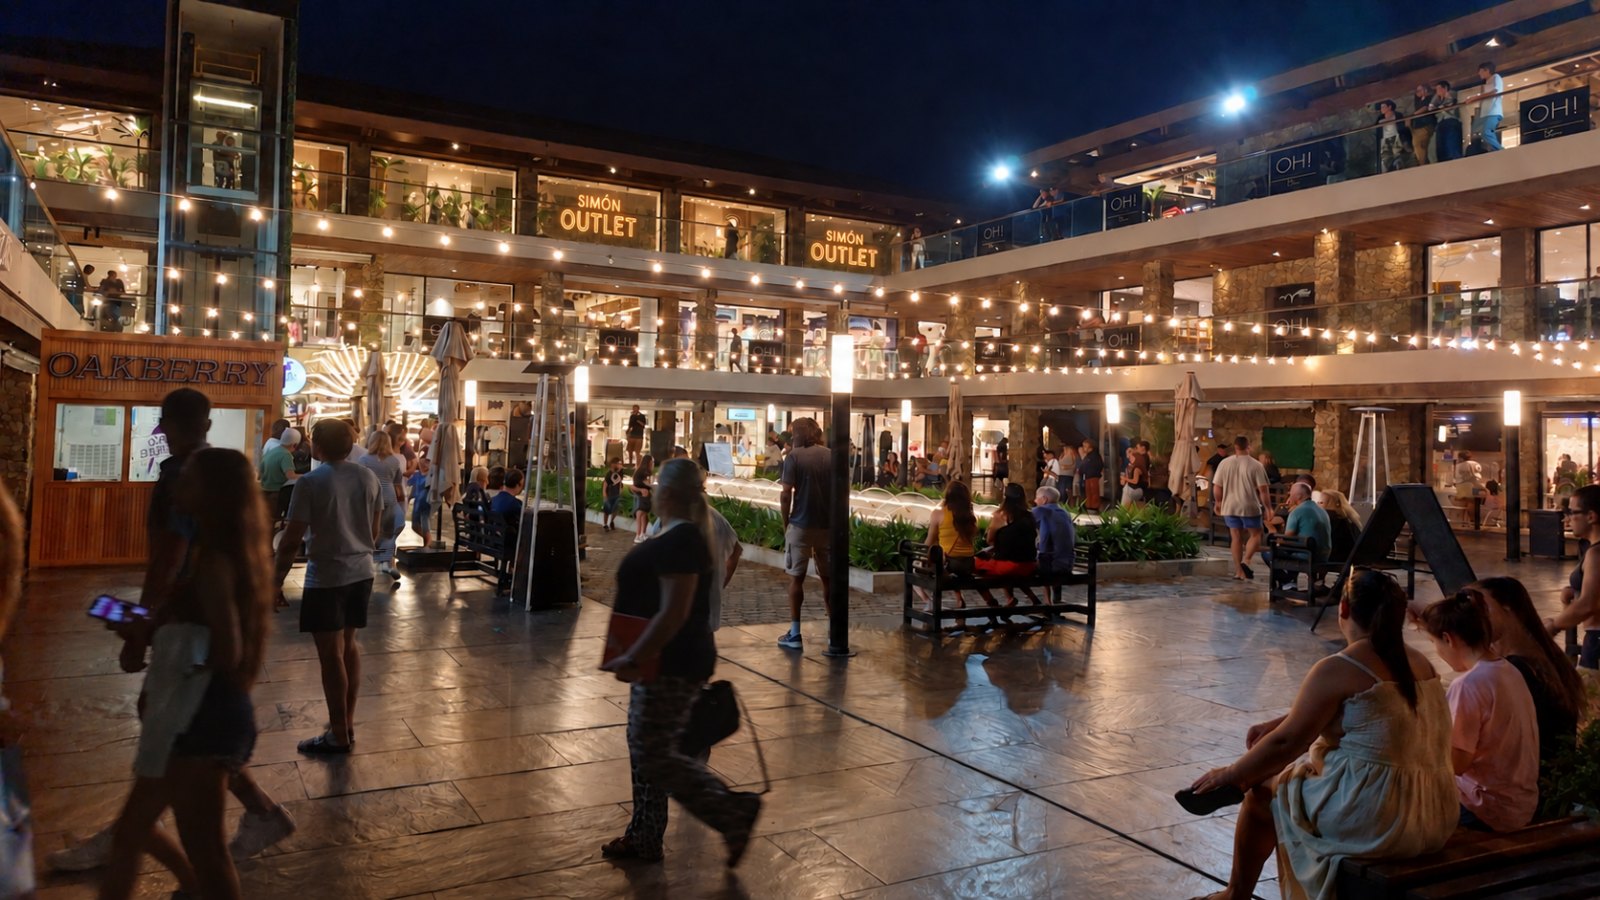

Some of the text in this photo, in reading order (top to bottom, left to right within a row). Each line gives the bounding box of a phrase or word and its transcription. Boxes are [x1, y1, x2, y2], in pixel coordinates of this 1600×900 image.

[1528, 96, 1577, 123] OH!
[1276, 152, 1311, 173] OH!
[578, 194, 621, 212] SIMÓN
[1110, 194, 1137, 211] OH!
[560, 209, 637, 237] OUTLET
[983, 225, 1004, 240] OH!
[826, 230, 864, 245] SIMÓN
[810, 242, 878, 268] OUTLET
[1108, 334, 1133, 348] OH!
[48, 352, 277, 386] OAKBERRY
